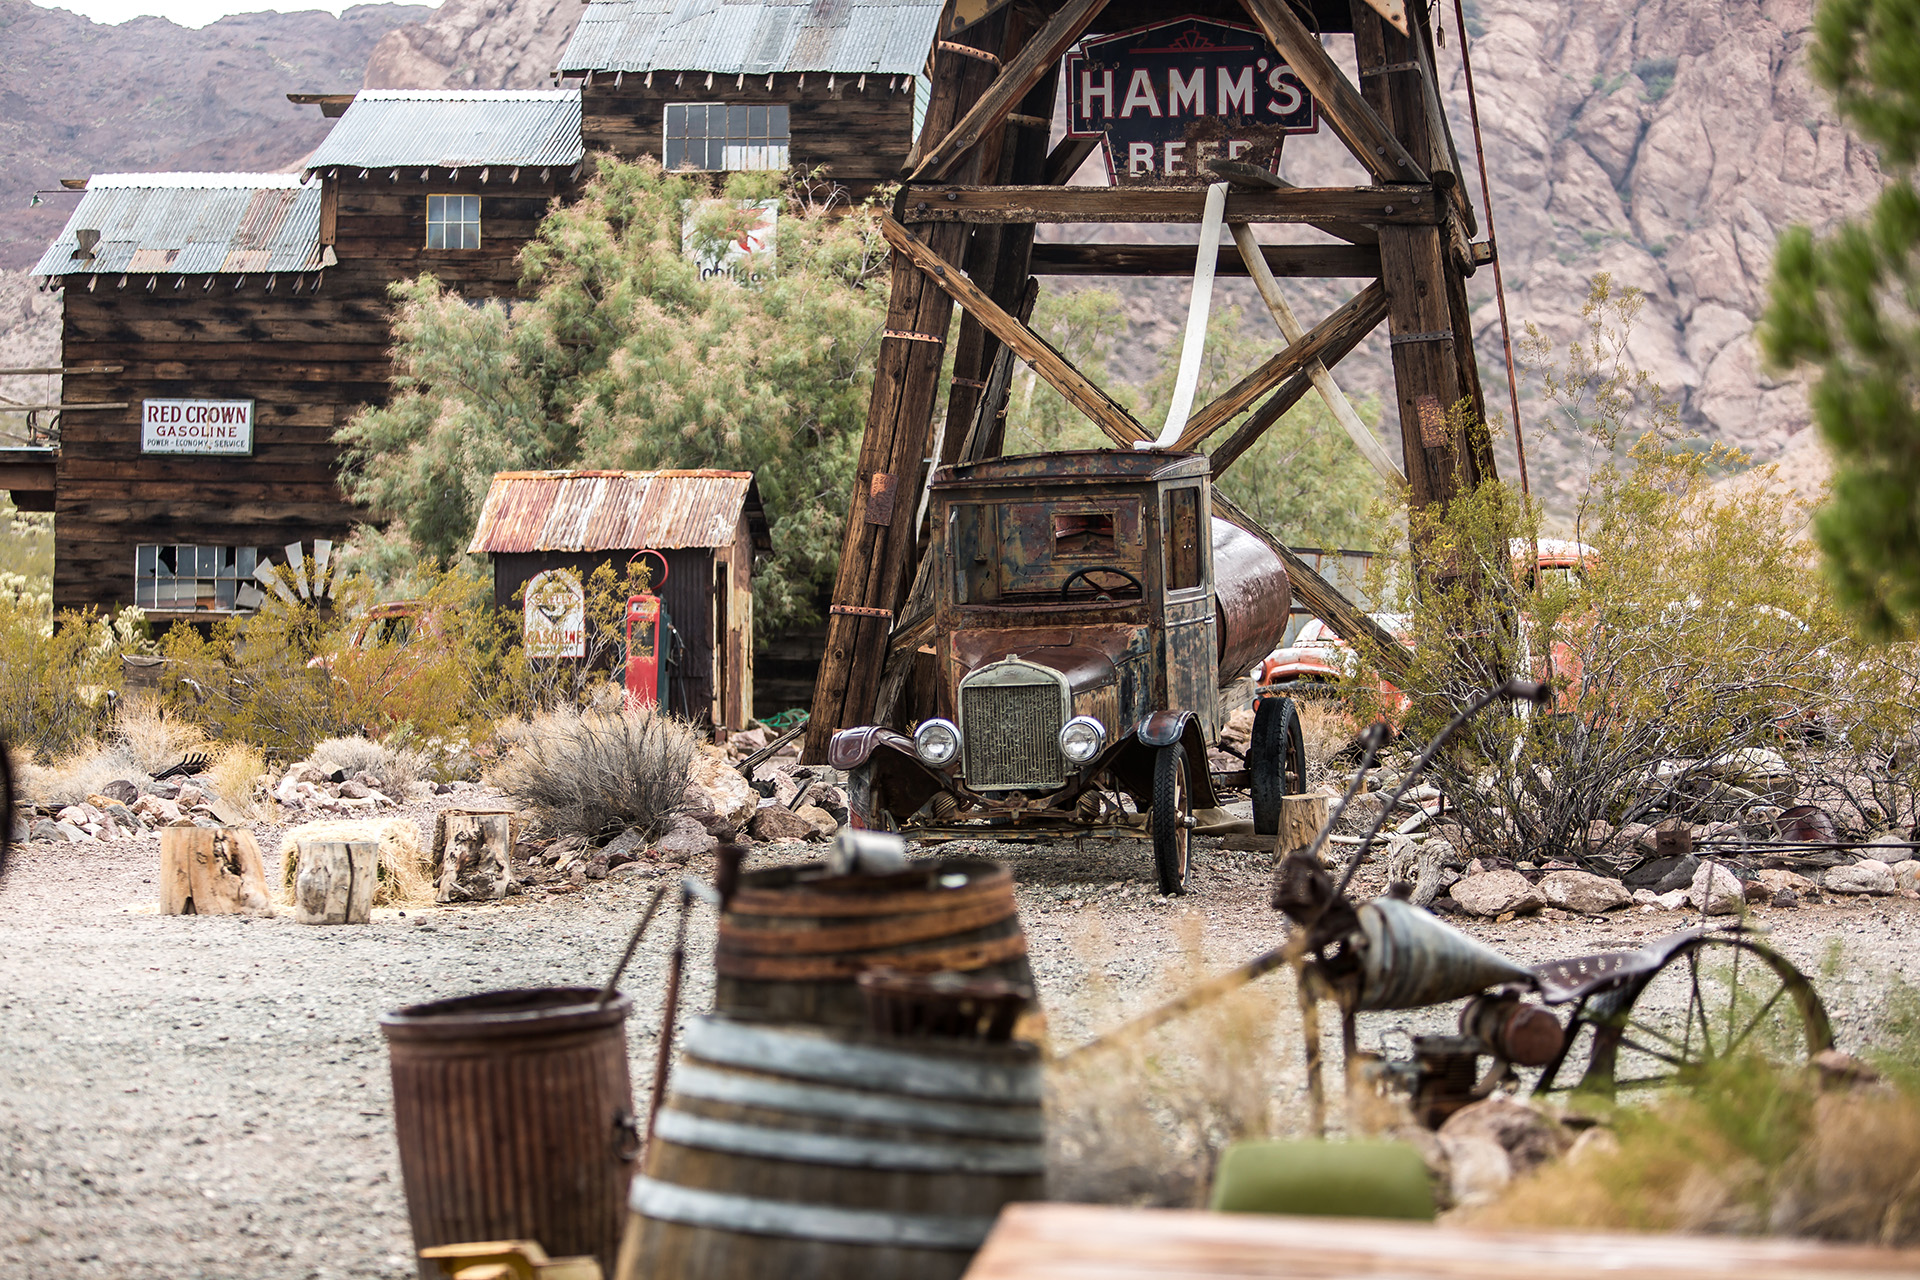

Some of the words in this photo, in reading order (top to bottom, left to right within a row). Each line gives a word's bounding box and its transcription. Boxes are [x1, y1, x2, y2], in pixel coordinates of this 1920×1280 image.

[1080, 57, 1303, 119] HAMM'S
[148, 405, 181, 423] RED
[186, 405, 247, 424] CROWN
[156, 425, 238, 438] GASOLINE
[147, 439, 169, 447] POWER
[175, 439, 208, 448] ECONOMY
[214, 439, 246, 448] SERVICE
[534, 594, 574, 605] SELLY
